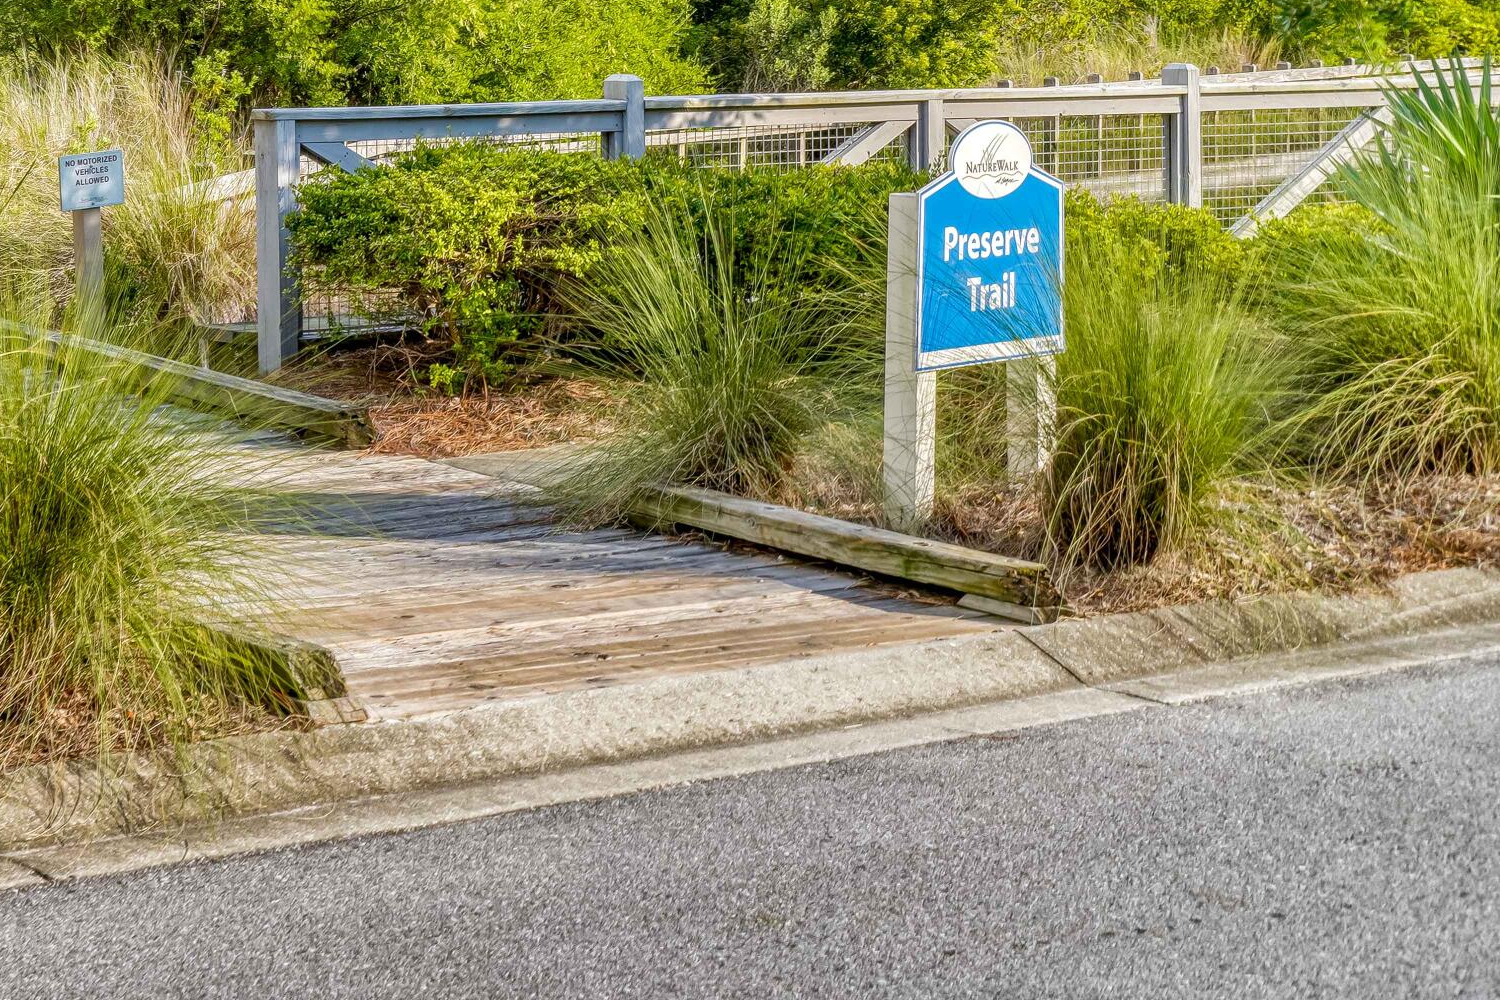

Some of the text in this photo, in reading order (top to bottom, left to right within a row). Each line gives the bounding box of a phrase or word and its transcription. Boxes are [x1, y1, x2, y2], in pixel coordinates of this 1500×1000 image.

[77, 155, 118, 166] MOTORIZED
[75, 166, 109, 176] VEHICLES
[76, 176, 110, 186] ALLOWED
[943, 225, 1040, 262] Preserve
[966, 272, 1016, 313] Trail
